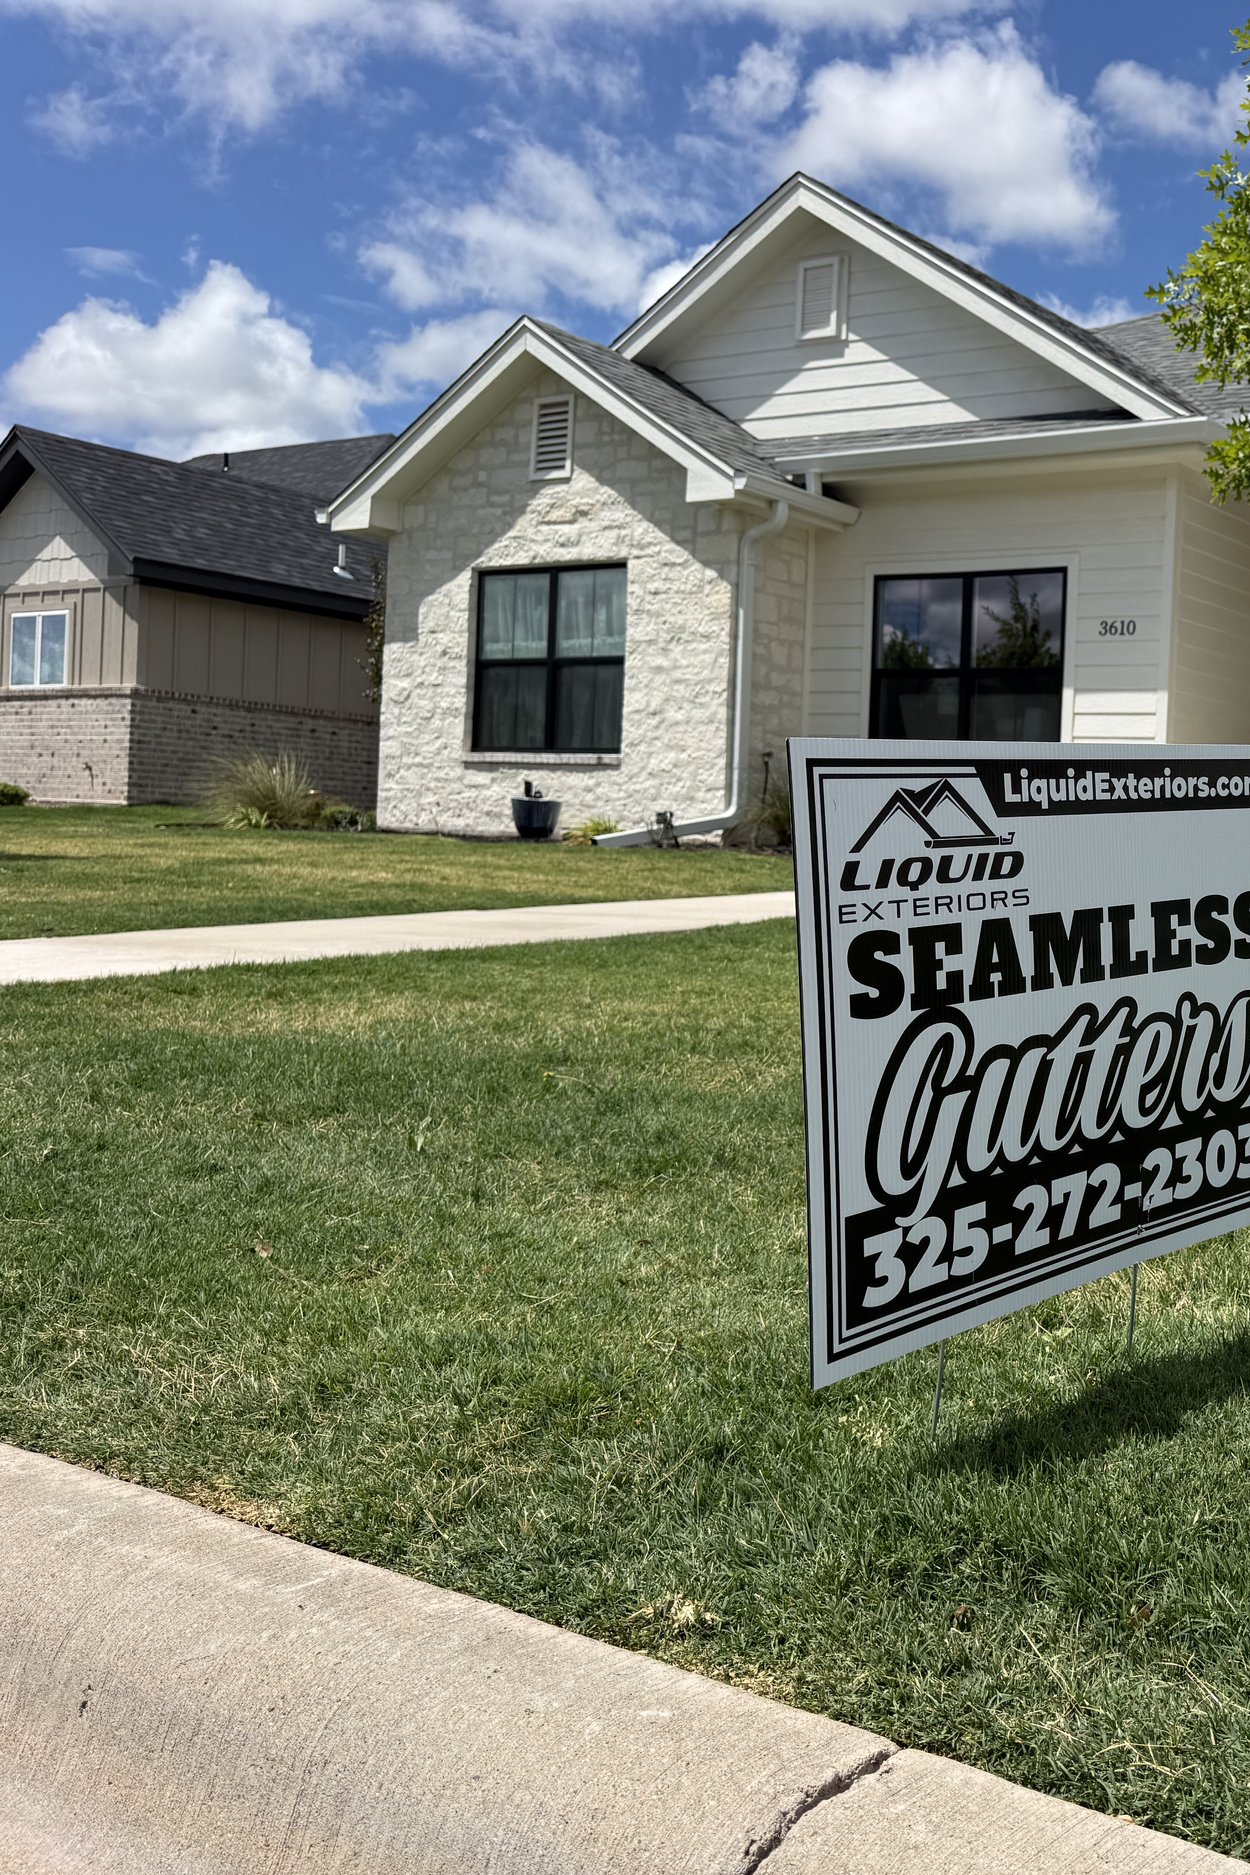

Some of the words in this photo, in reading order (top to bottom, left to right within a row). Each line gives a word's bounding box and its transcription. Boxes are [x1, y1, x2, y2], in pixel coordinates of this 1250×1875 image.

[1098, 619, 1136, 636] 3610
[839, 850, 1025, 892] LIQUID
[838, 888, 1030, 924] EXTERIORS
